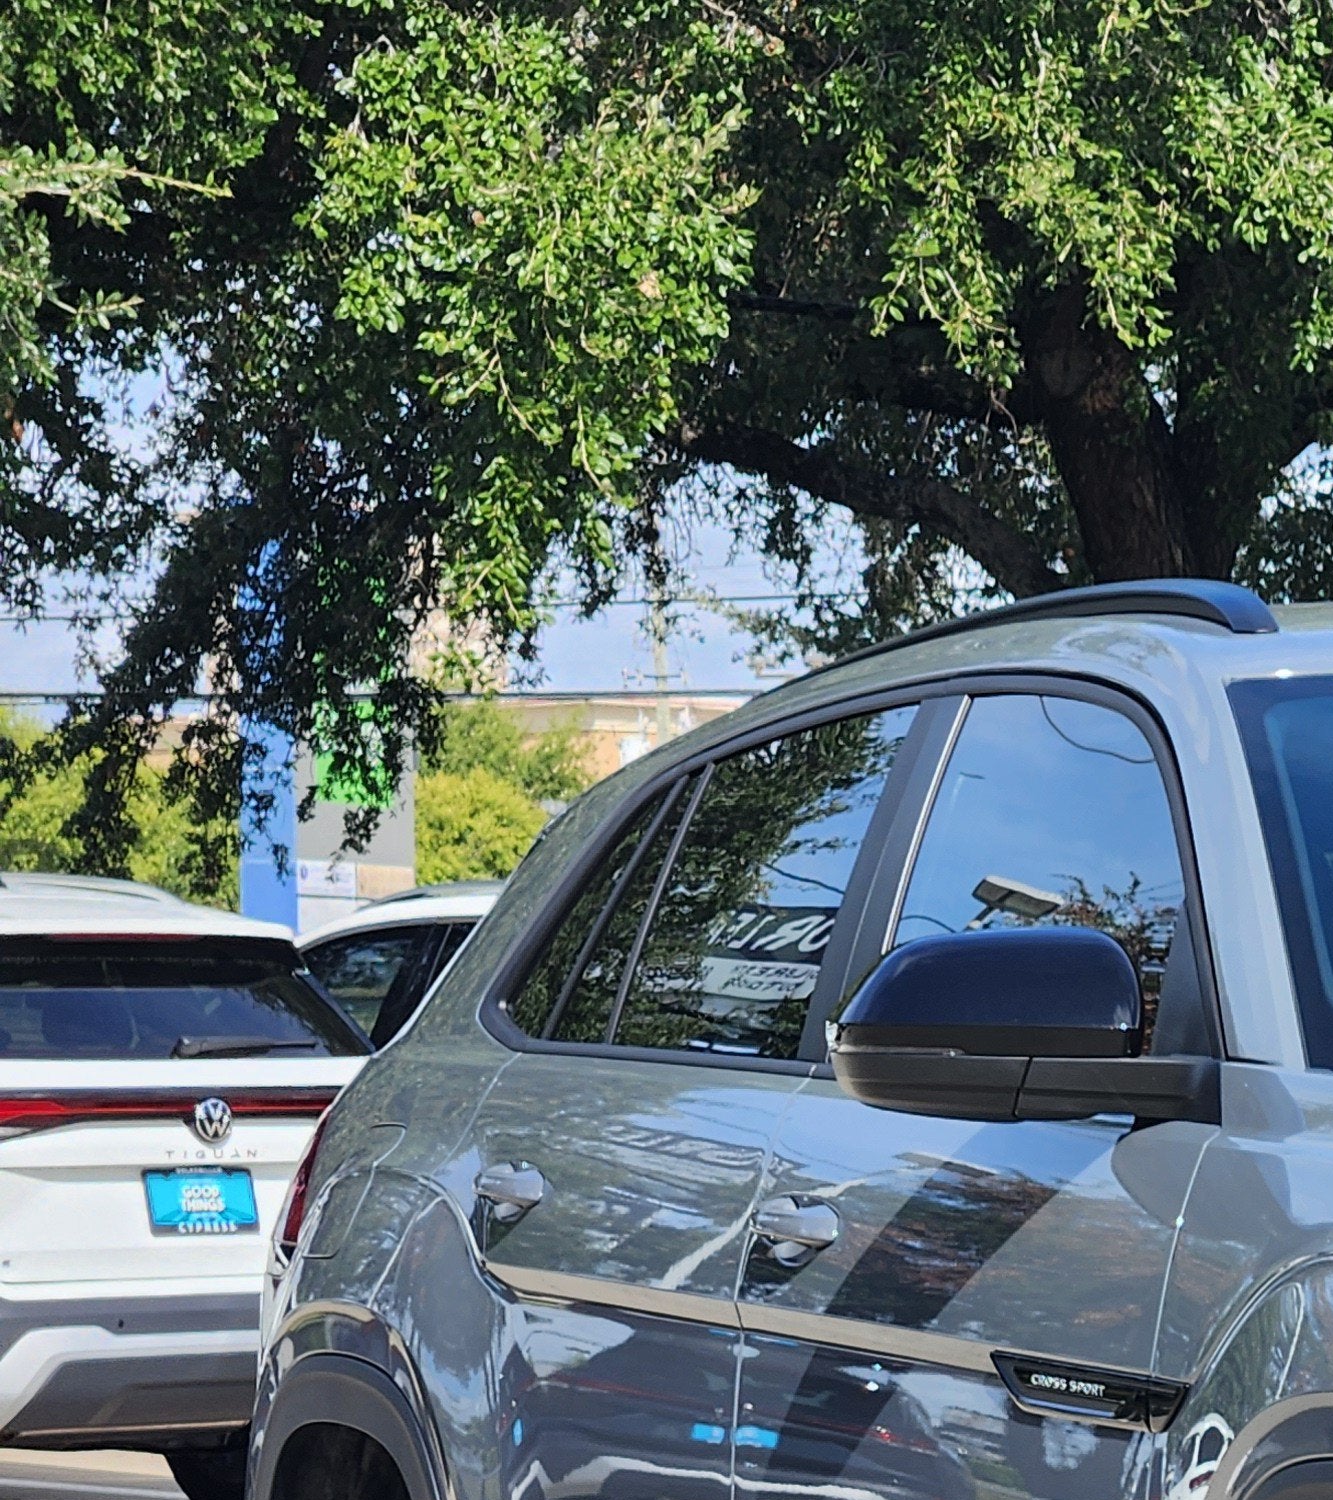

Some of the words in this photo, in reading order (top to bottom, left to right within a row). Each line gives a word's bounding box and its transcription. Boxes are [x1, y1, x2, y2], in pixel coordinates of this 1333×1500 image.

[166, 1150, 257, 1159] TIGUAN
[183, 1184, 220, 1198] GOOD
[178, 1219, 238, 1234] CYPRESS
[1030, 1374, 1067, 1390] CROSS
[1069, 1380, 1105, 1397] SPORT
